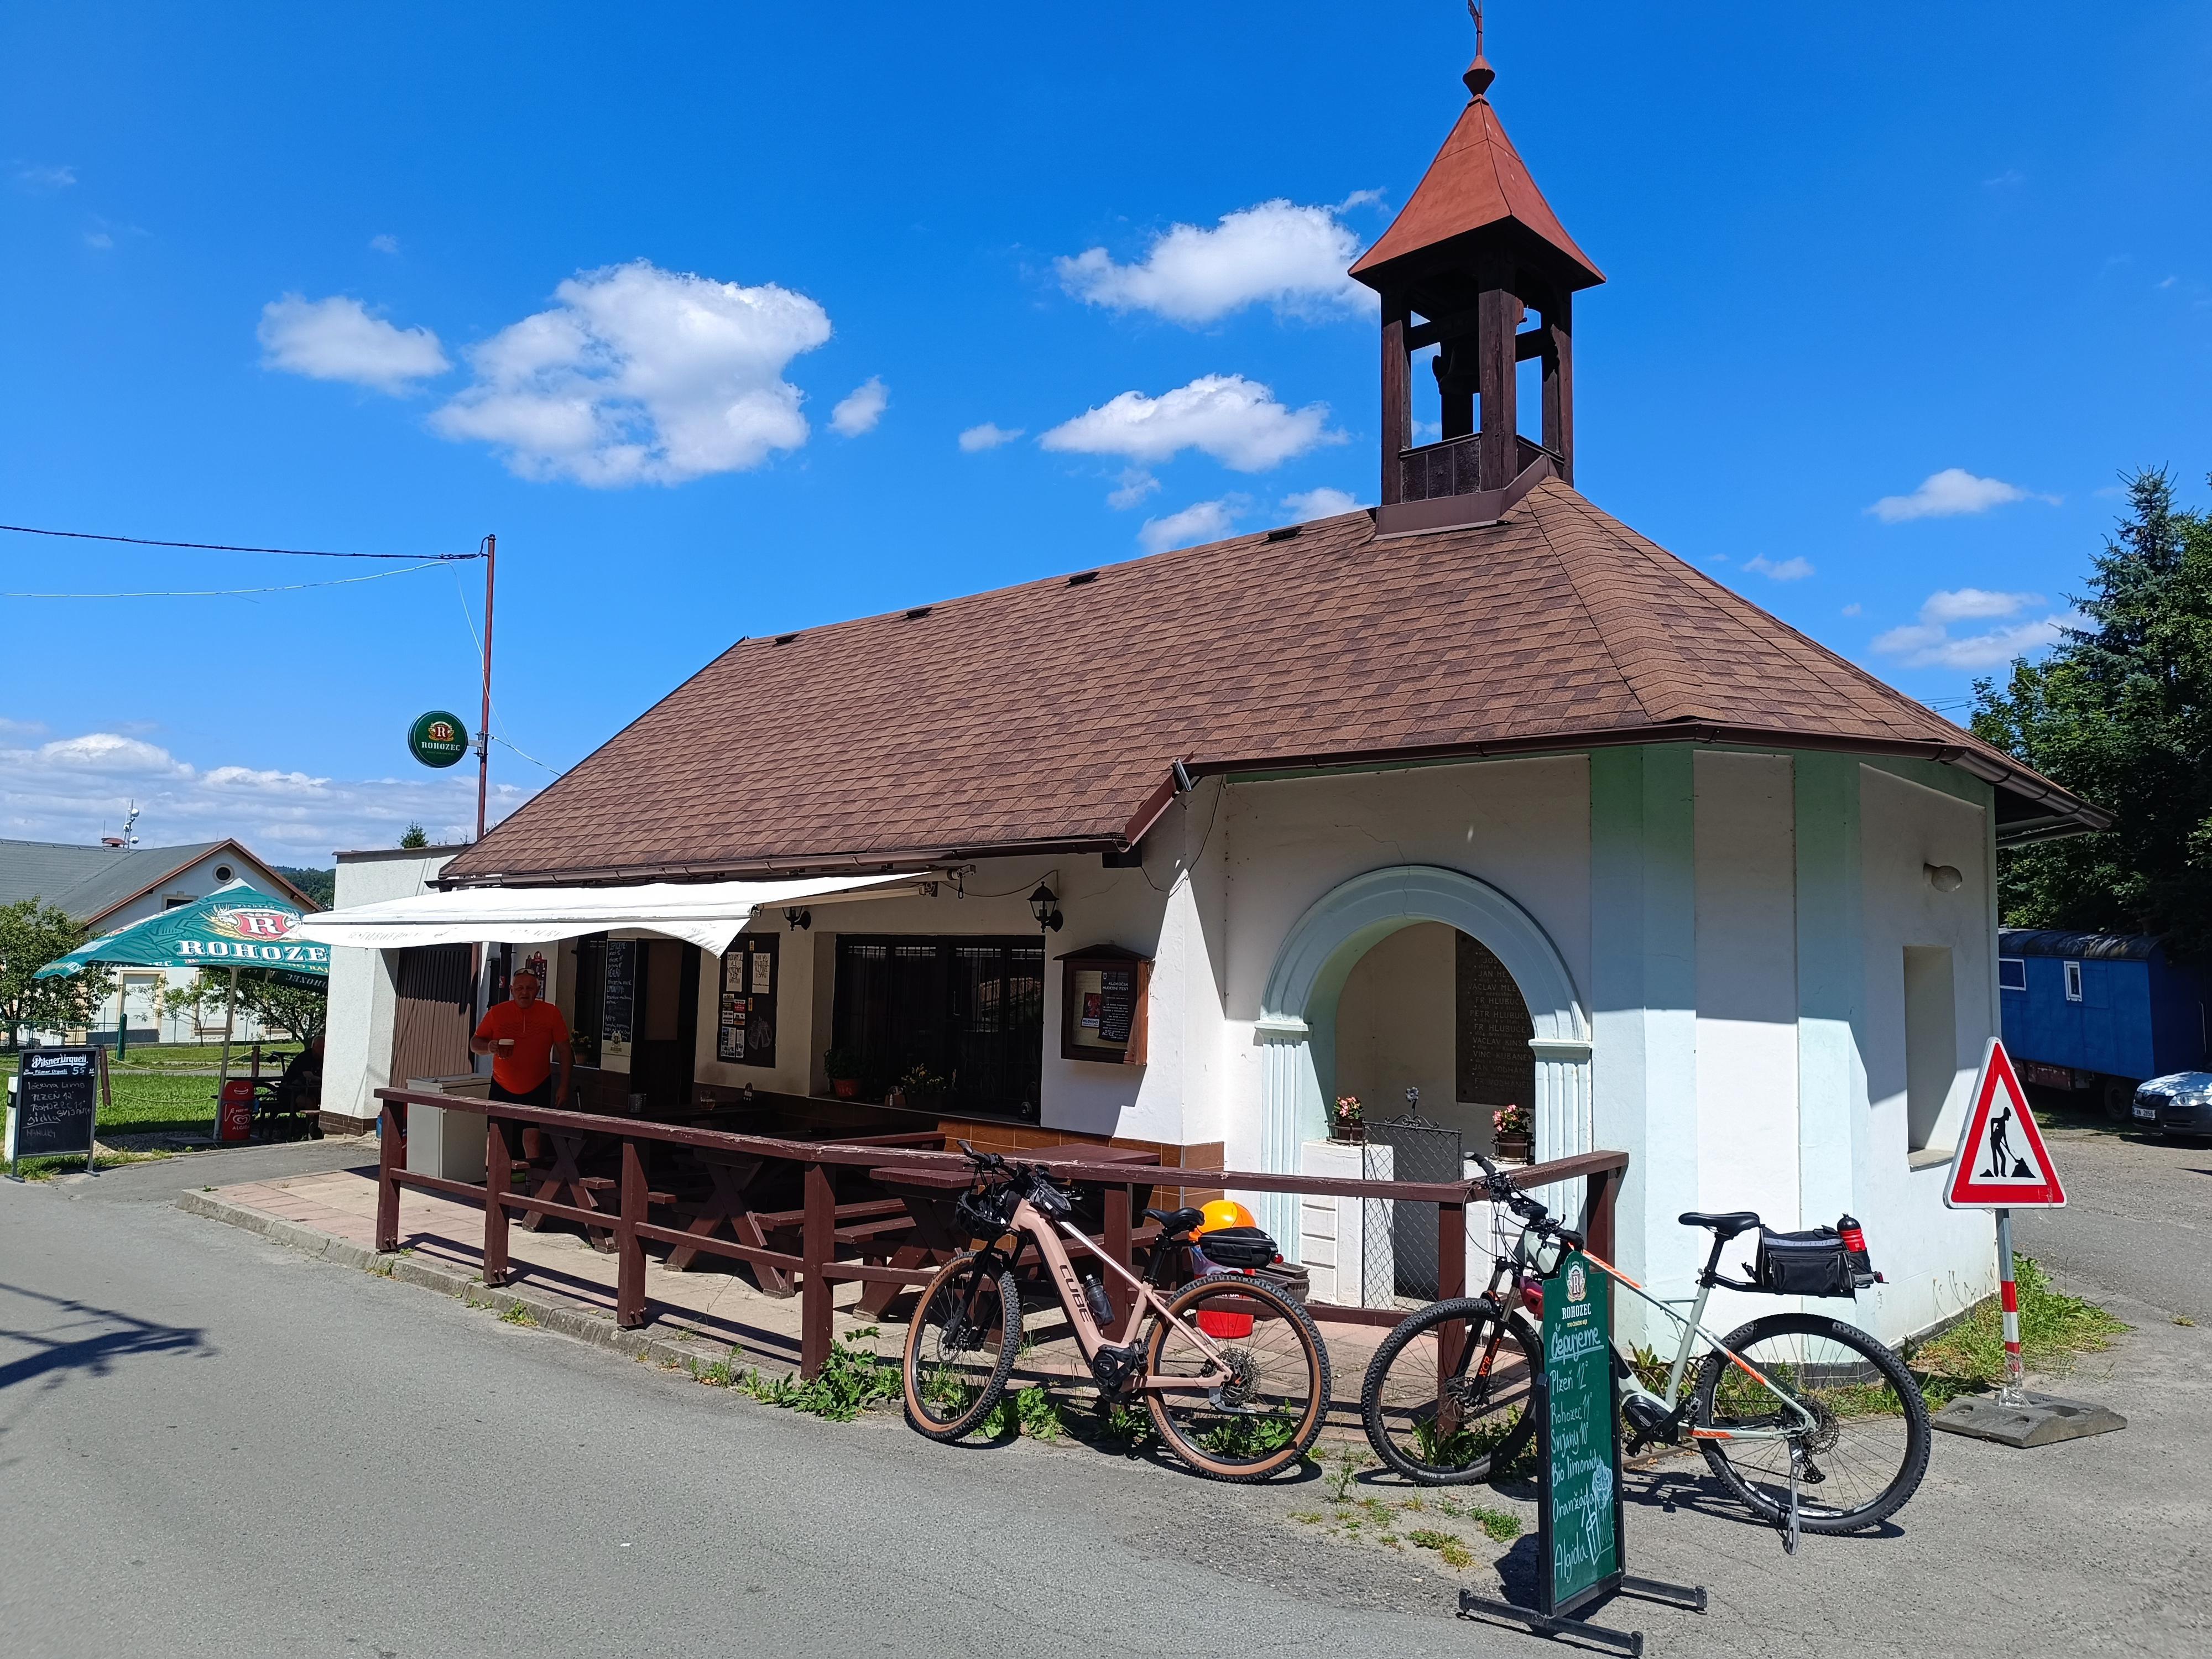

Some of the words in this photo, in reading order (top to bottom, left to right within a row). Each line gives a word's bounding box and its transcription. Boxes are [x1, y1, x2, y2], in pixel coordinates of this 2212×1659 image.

[421, 742, 460, 751] ROHOZEC
[243, 916, 282, 935] R
[178, 940, 328, 962] ROHOZE
[32, 1055, 60, 1068] Pilsner
[1059, 1265, 1092, 1323] CUBE
[1561, 1302, 1592, 1320] ROHOZEC
[1551, 1322, 1601, 1365] Čepujeme
[1478, 1355, 1492, 1378] XCR
[1550, 1369, 1573, 1396] Plzeň
[1550, 1401, 1582, 1426] Rohozec
[1551, 1428, 1579, 1458] Svijany
[1552, 1483, 1595, 1523] Oranžáda
[1554, 1531, 1588, 1583] Algida
